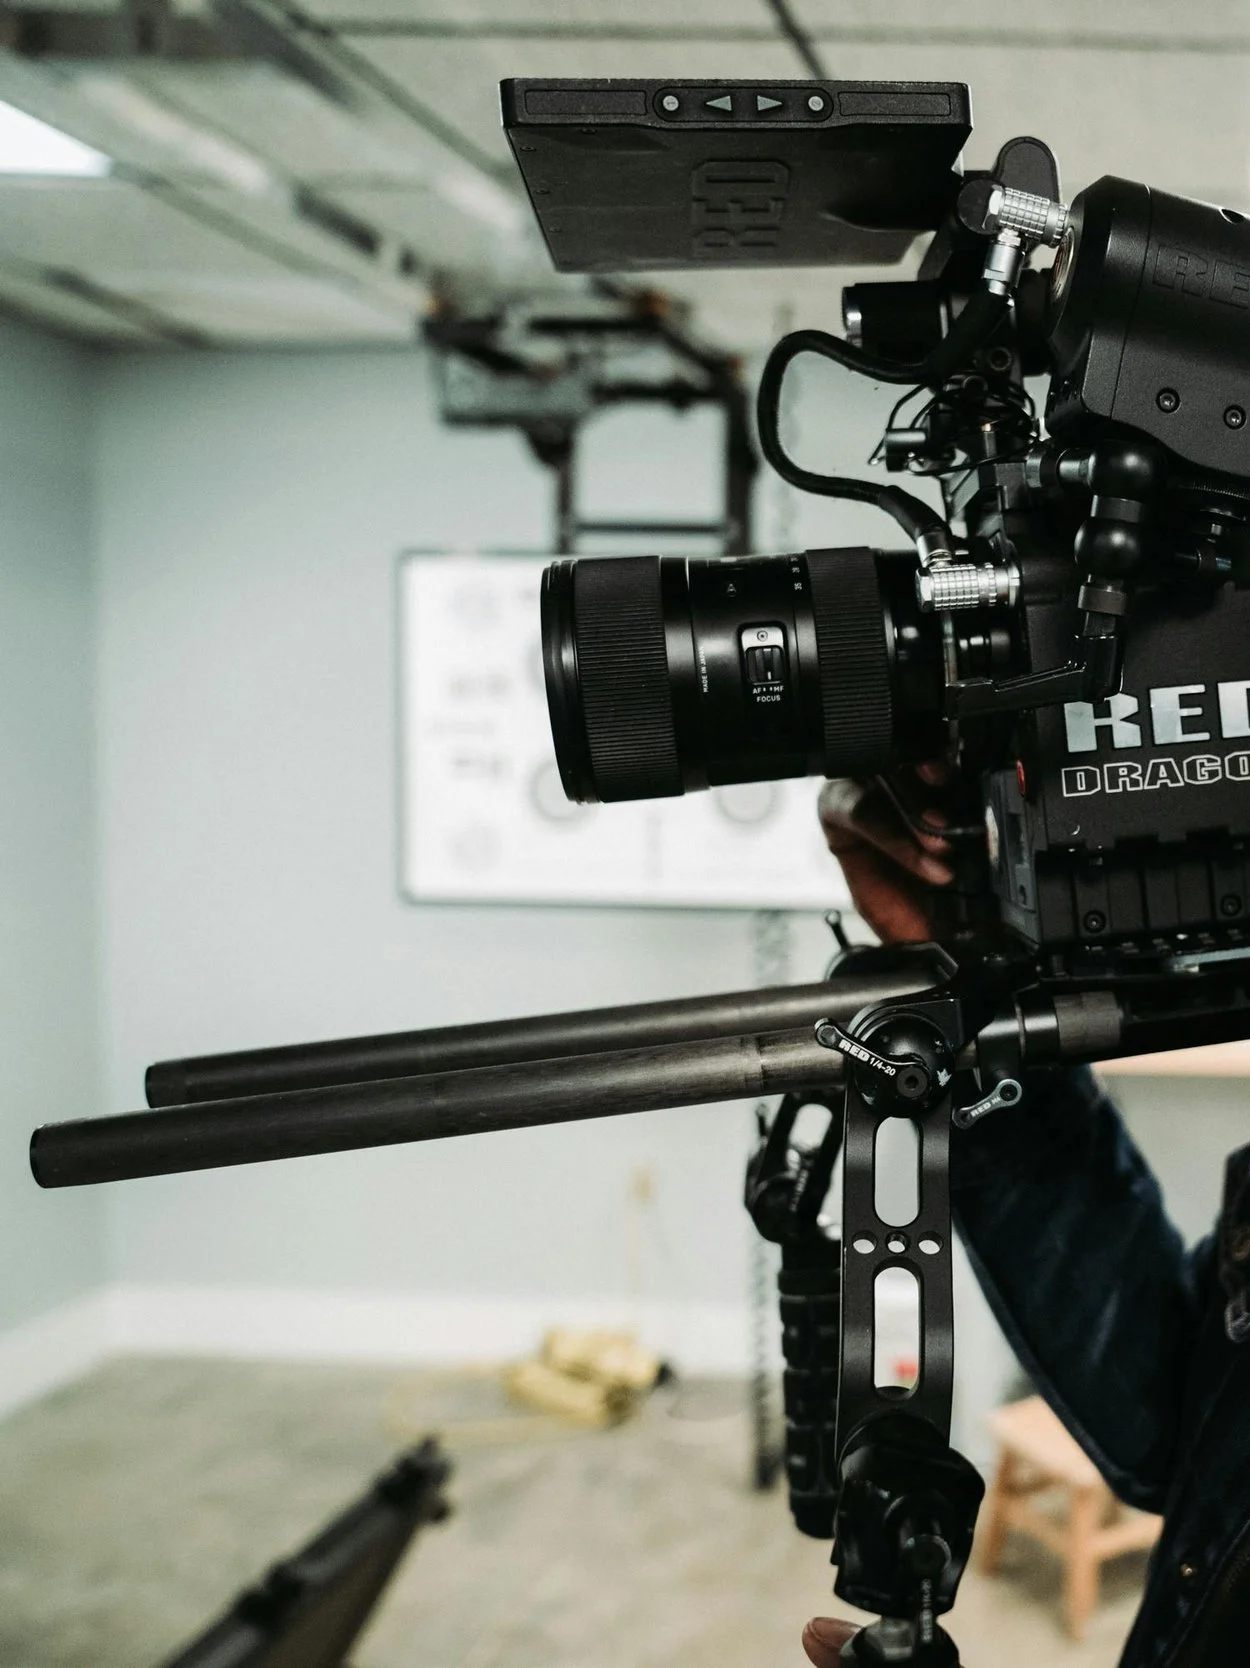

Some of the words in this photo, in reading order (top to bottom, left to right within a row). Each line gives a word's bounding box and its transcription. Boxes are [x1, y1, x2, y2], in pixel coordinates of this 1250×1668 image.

[691, 159, 790, 258] RED
[756, 694, 781, 703] FOCUS
[838, 1039, 871, 1062] RED
[870, 1057, 896, 1076] 1/4-20
[970, 1102, 991, 1117] RED
